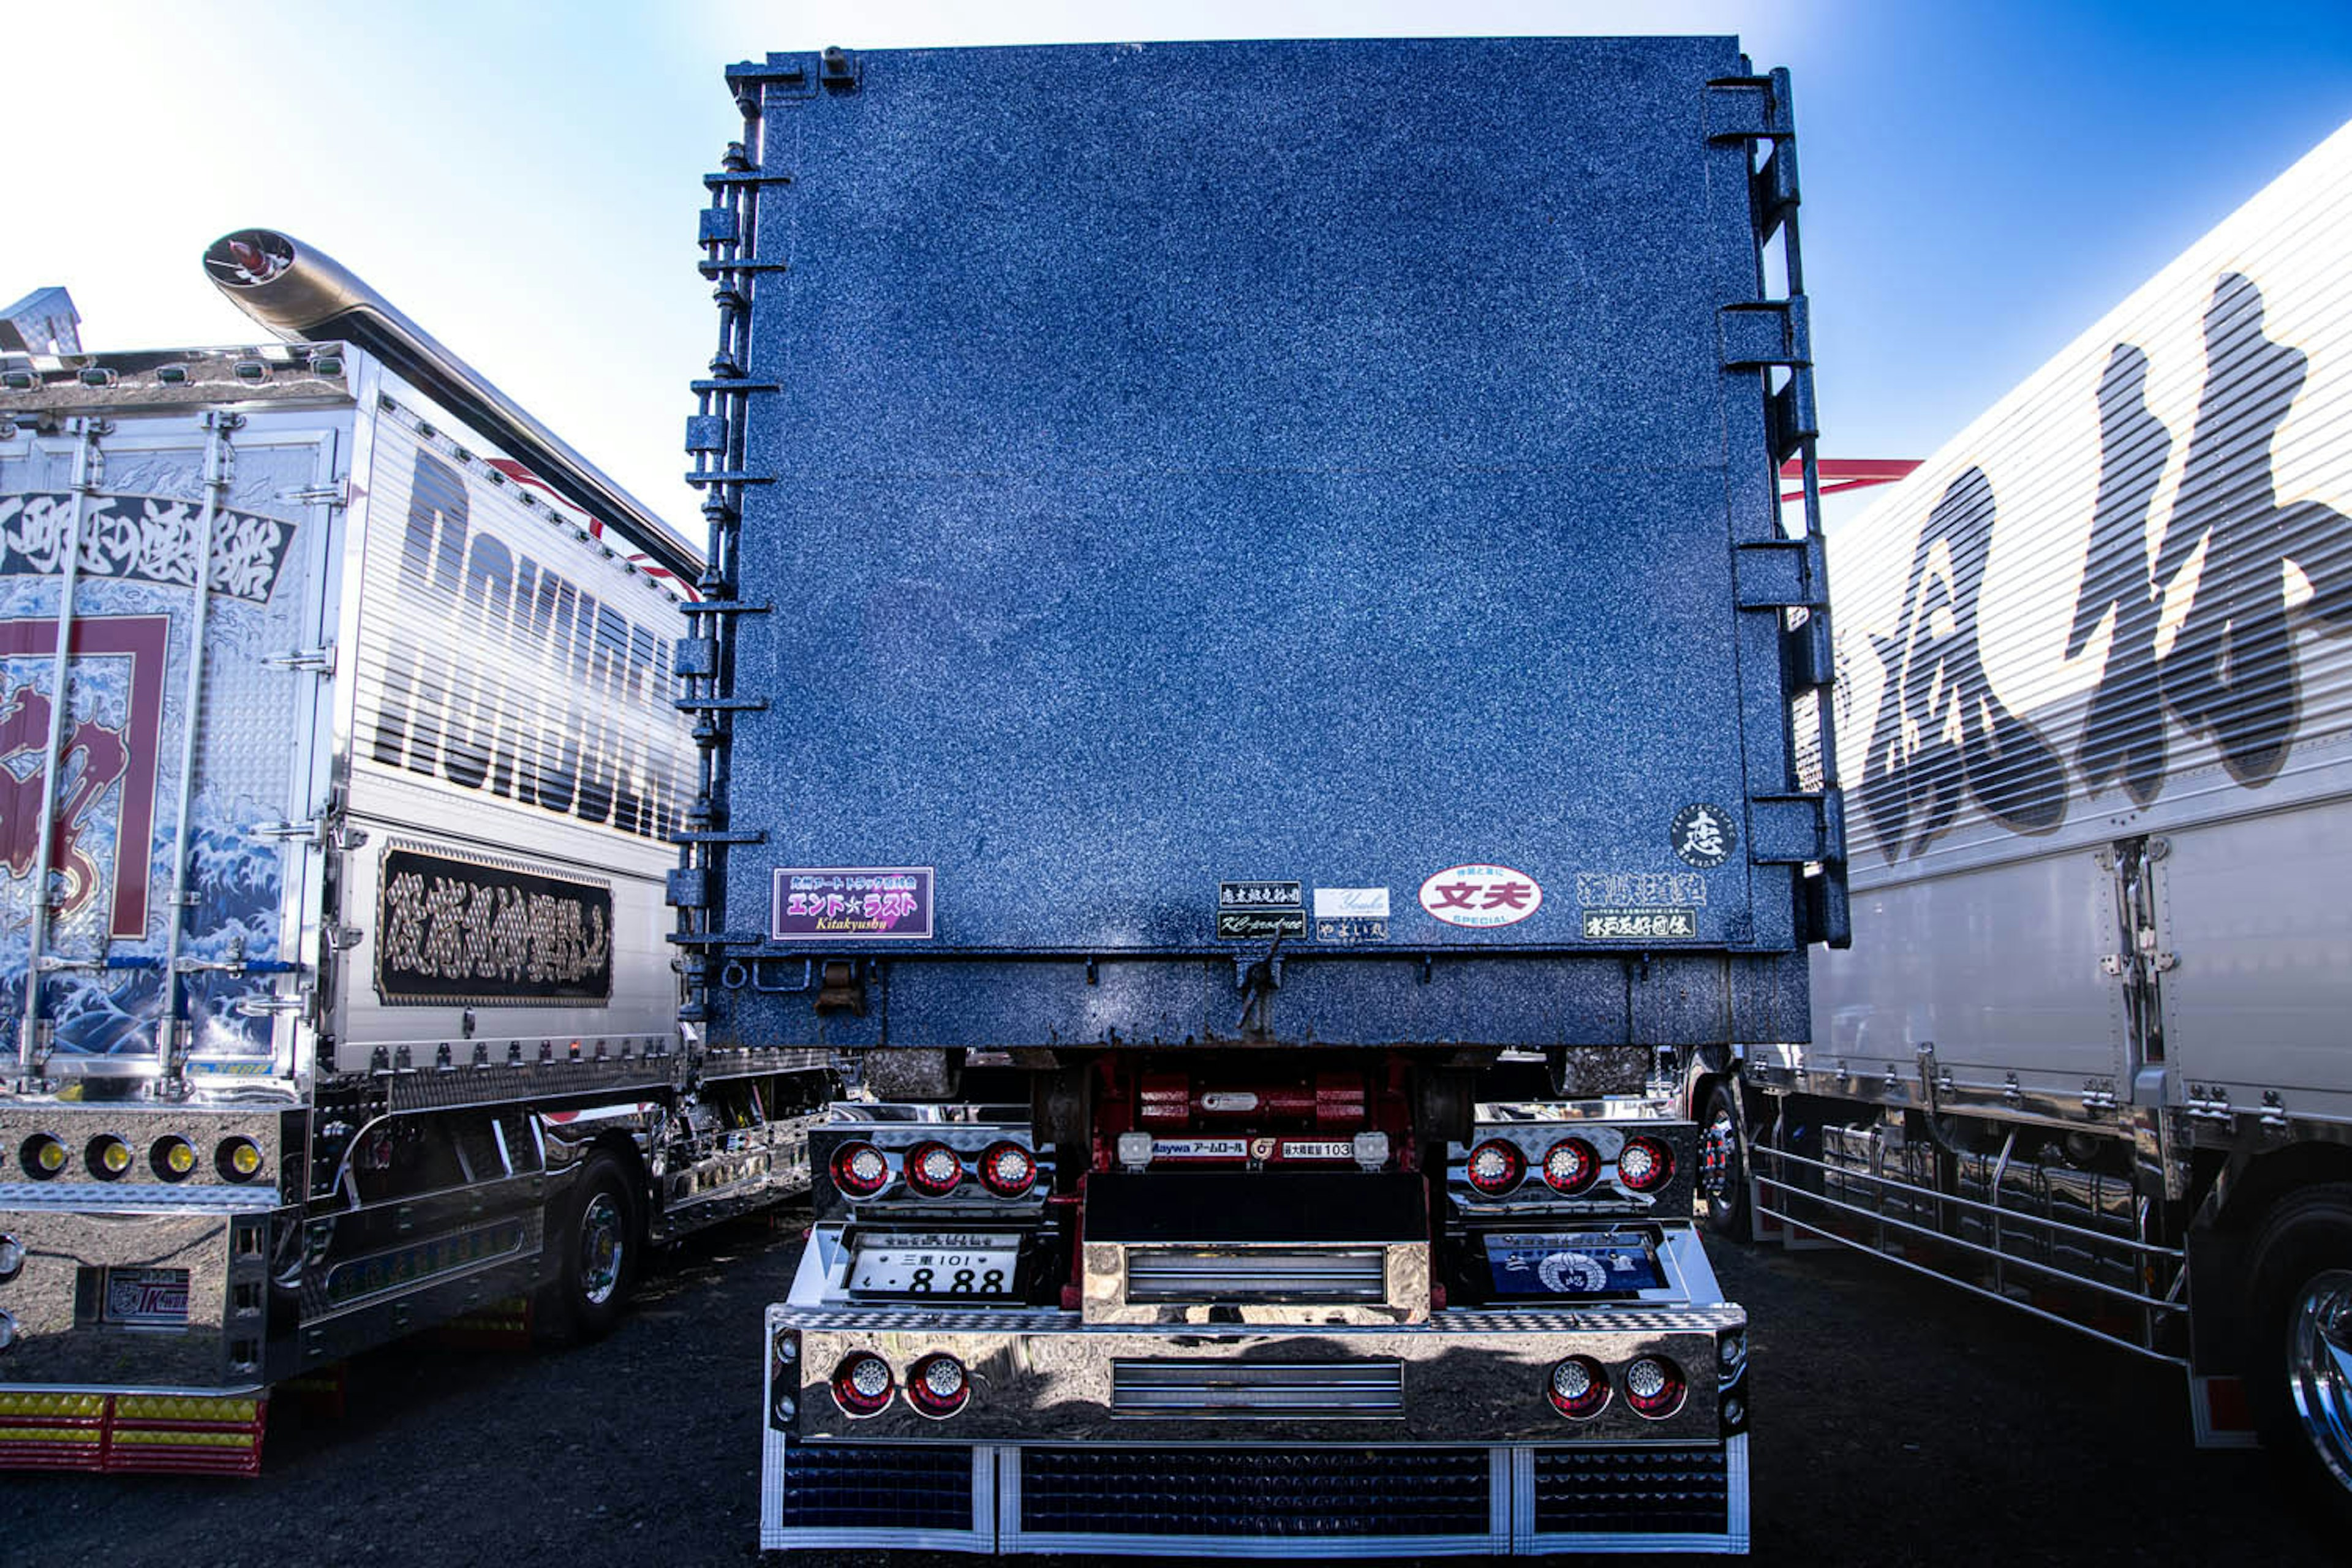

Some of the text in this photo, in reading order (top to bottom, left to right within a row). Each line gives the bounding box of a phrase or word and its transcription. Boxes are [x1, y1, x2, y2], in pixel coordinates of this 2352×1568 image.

[1429, 881, 1531, 910] 文夫
[815, 917, 888, 932] Kitakyushu
[1193, 1142, 1243, 1153] アームロール
